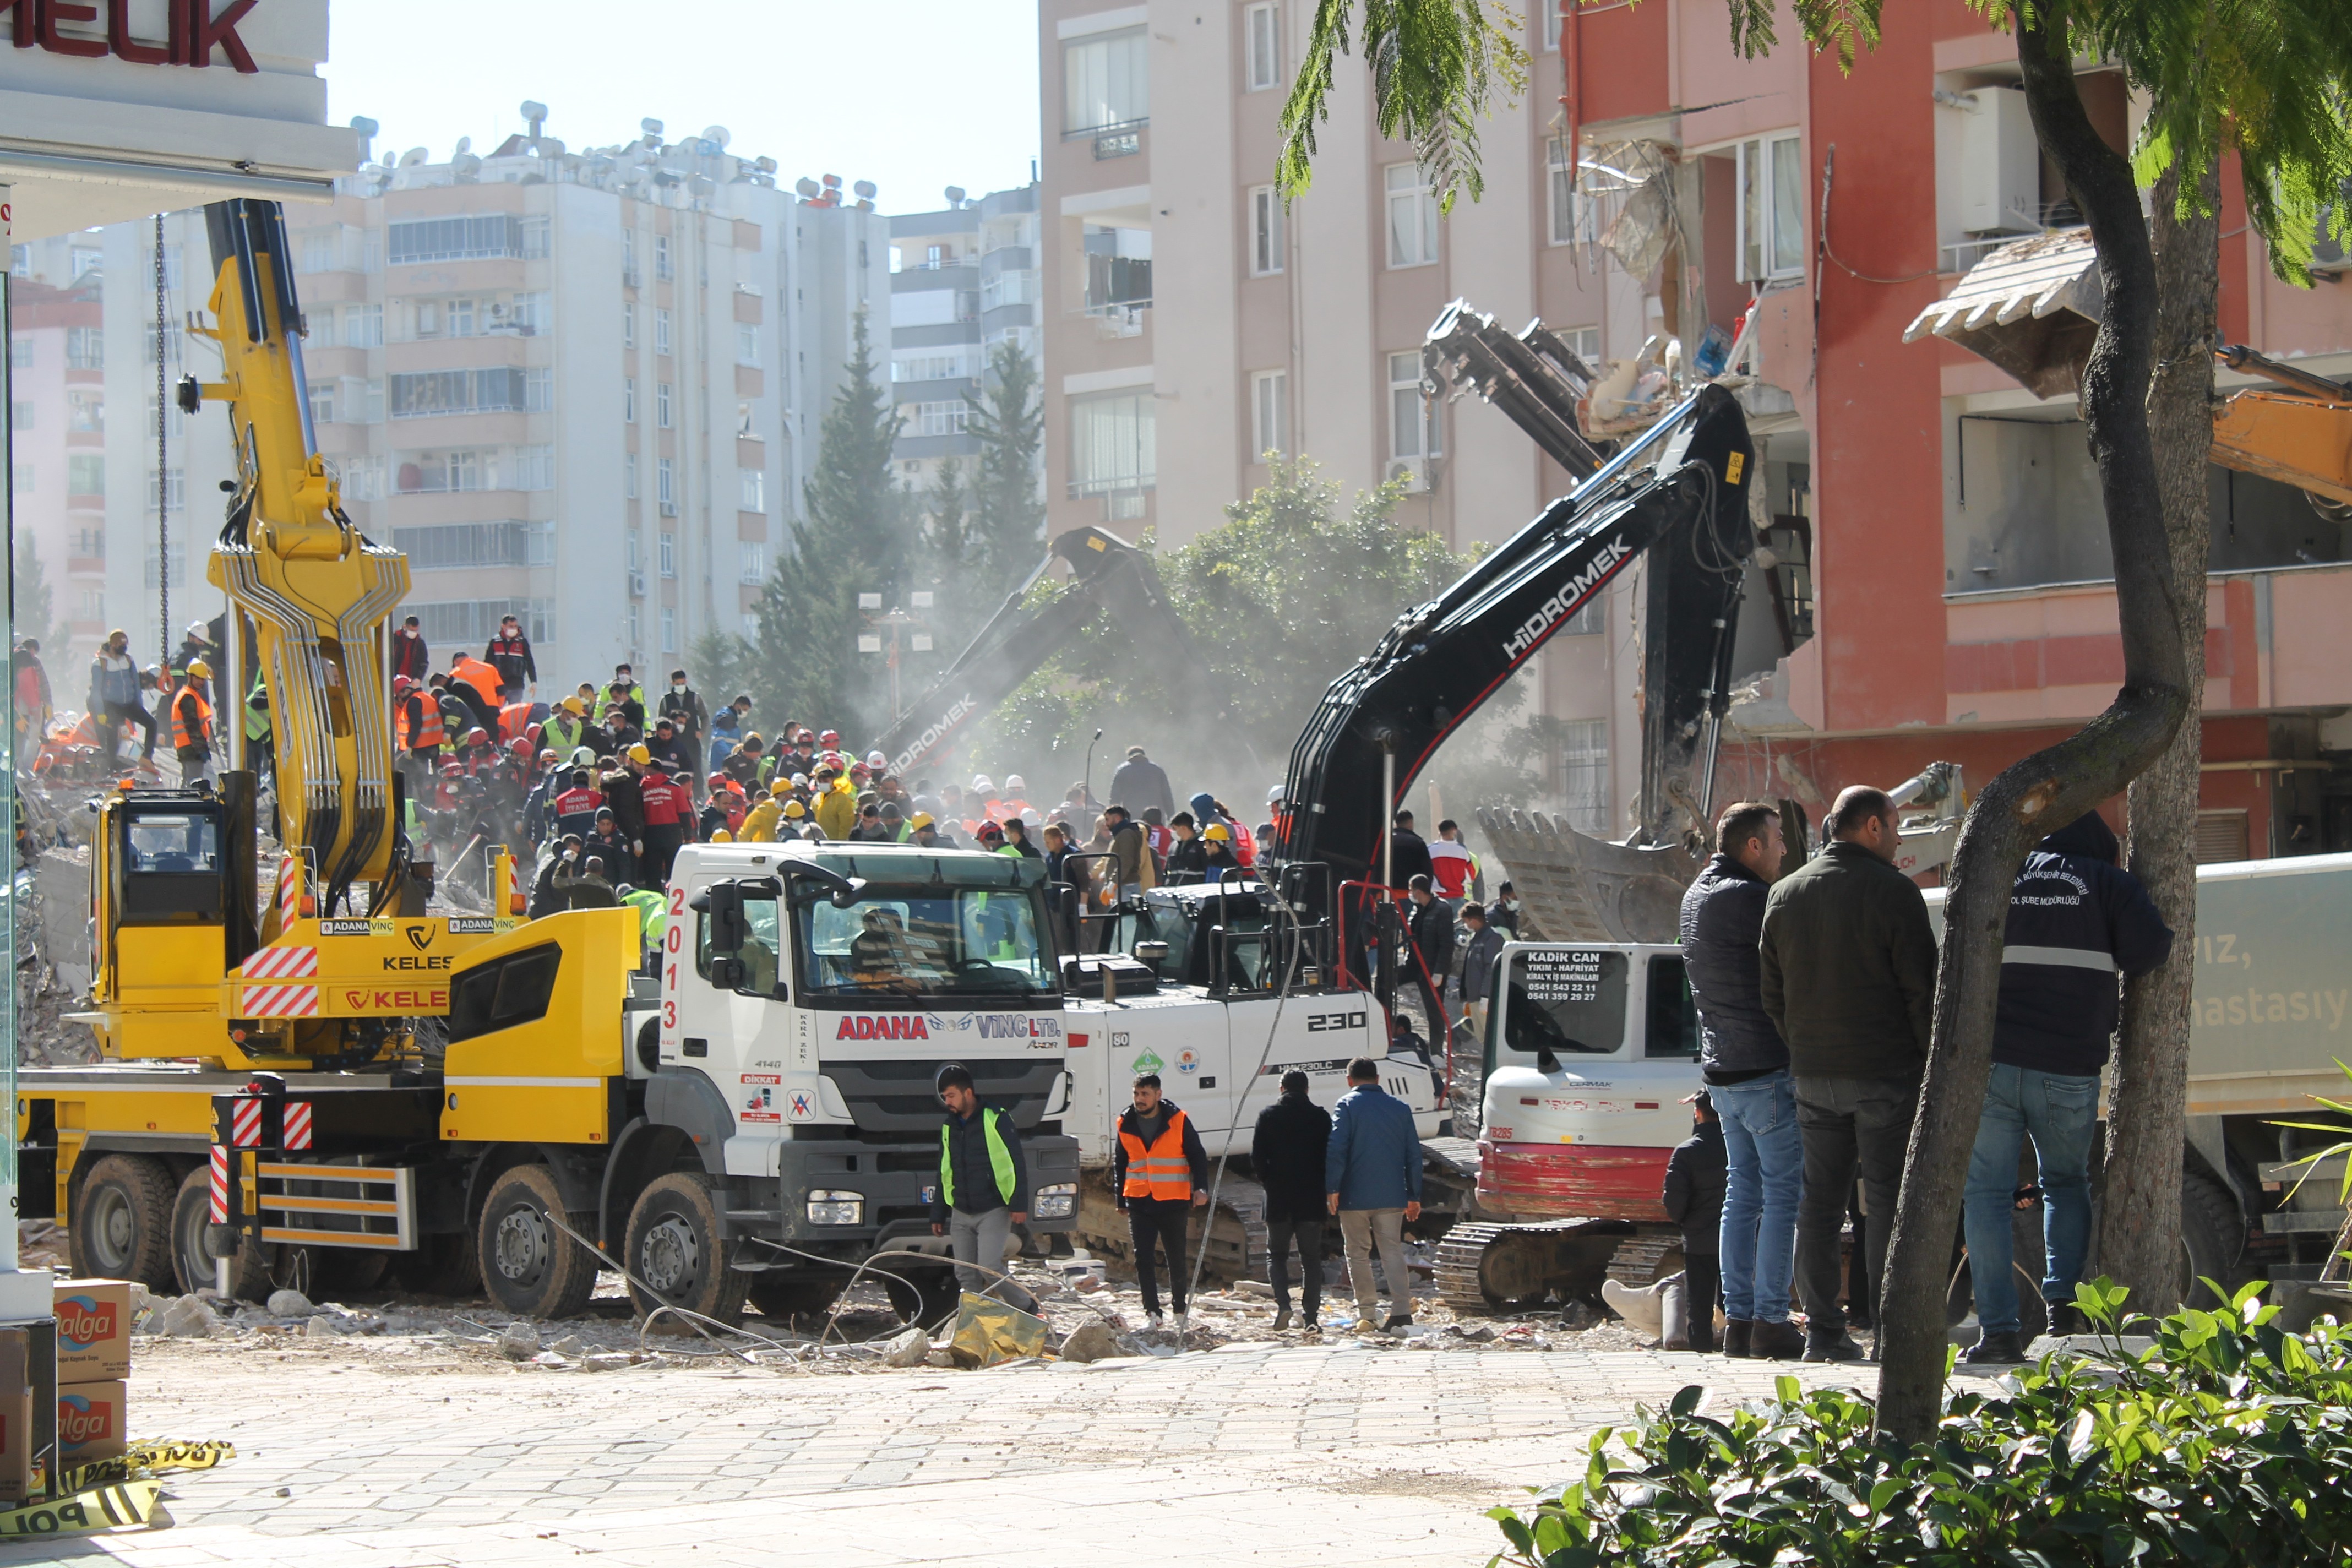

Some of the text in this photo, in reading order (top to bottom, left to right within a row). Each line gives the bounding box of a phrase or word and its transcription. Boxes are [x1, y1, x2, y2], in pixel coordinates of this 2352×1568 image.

[565, 795, 589, 804] ADANA
[1892, 855, 1917, 869] UCHI
[2013, 870, 2089, 895] NA BÜYÜKŞEHİR BELEDİYESİ
[2010, 895, 2080, 906] OL ŞUBE MÜDÜRLÜĞÜ
[334, 920, 394, 933] ADANA VİNÇ
[461, 918, 515, 929] ADANA VİNÇ
[663, 888, 685, 1030] 2013
[1572, 953, 1600, 962] CAN
[1559, 963, 1599, 972] HAFRİYAT
[1553, 972, 1559, 982] İŞ
[1560, 973, 1599, 981] MAKİNALARI
[374, 990, 447, 1008] KELE
[1307, 1011, 1366, 1032] 230
[836, 1016, 929, 1041] ADANA
[1029, 1017, 1061, 1038] LTD.
[1113, 1033, 1129, 1046] 80
[744, 1075, 777, 1084] DİKKAT
[58, 1408, 105, 1441] alga
